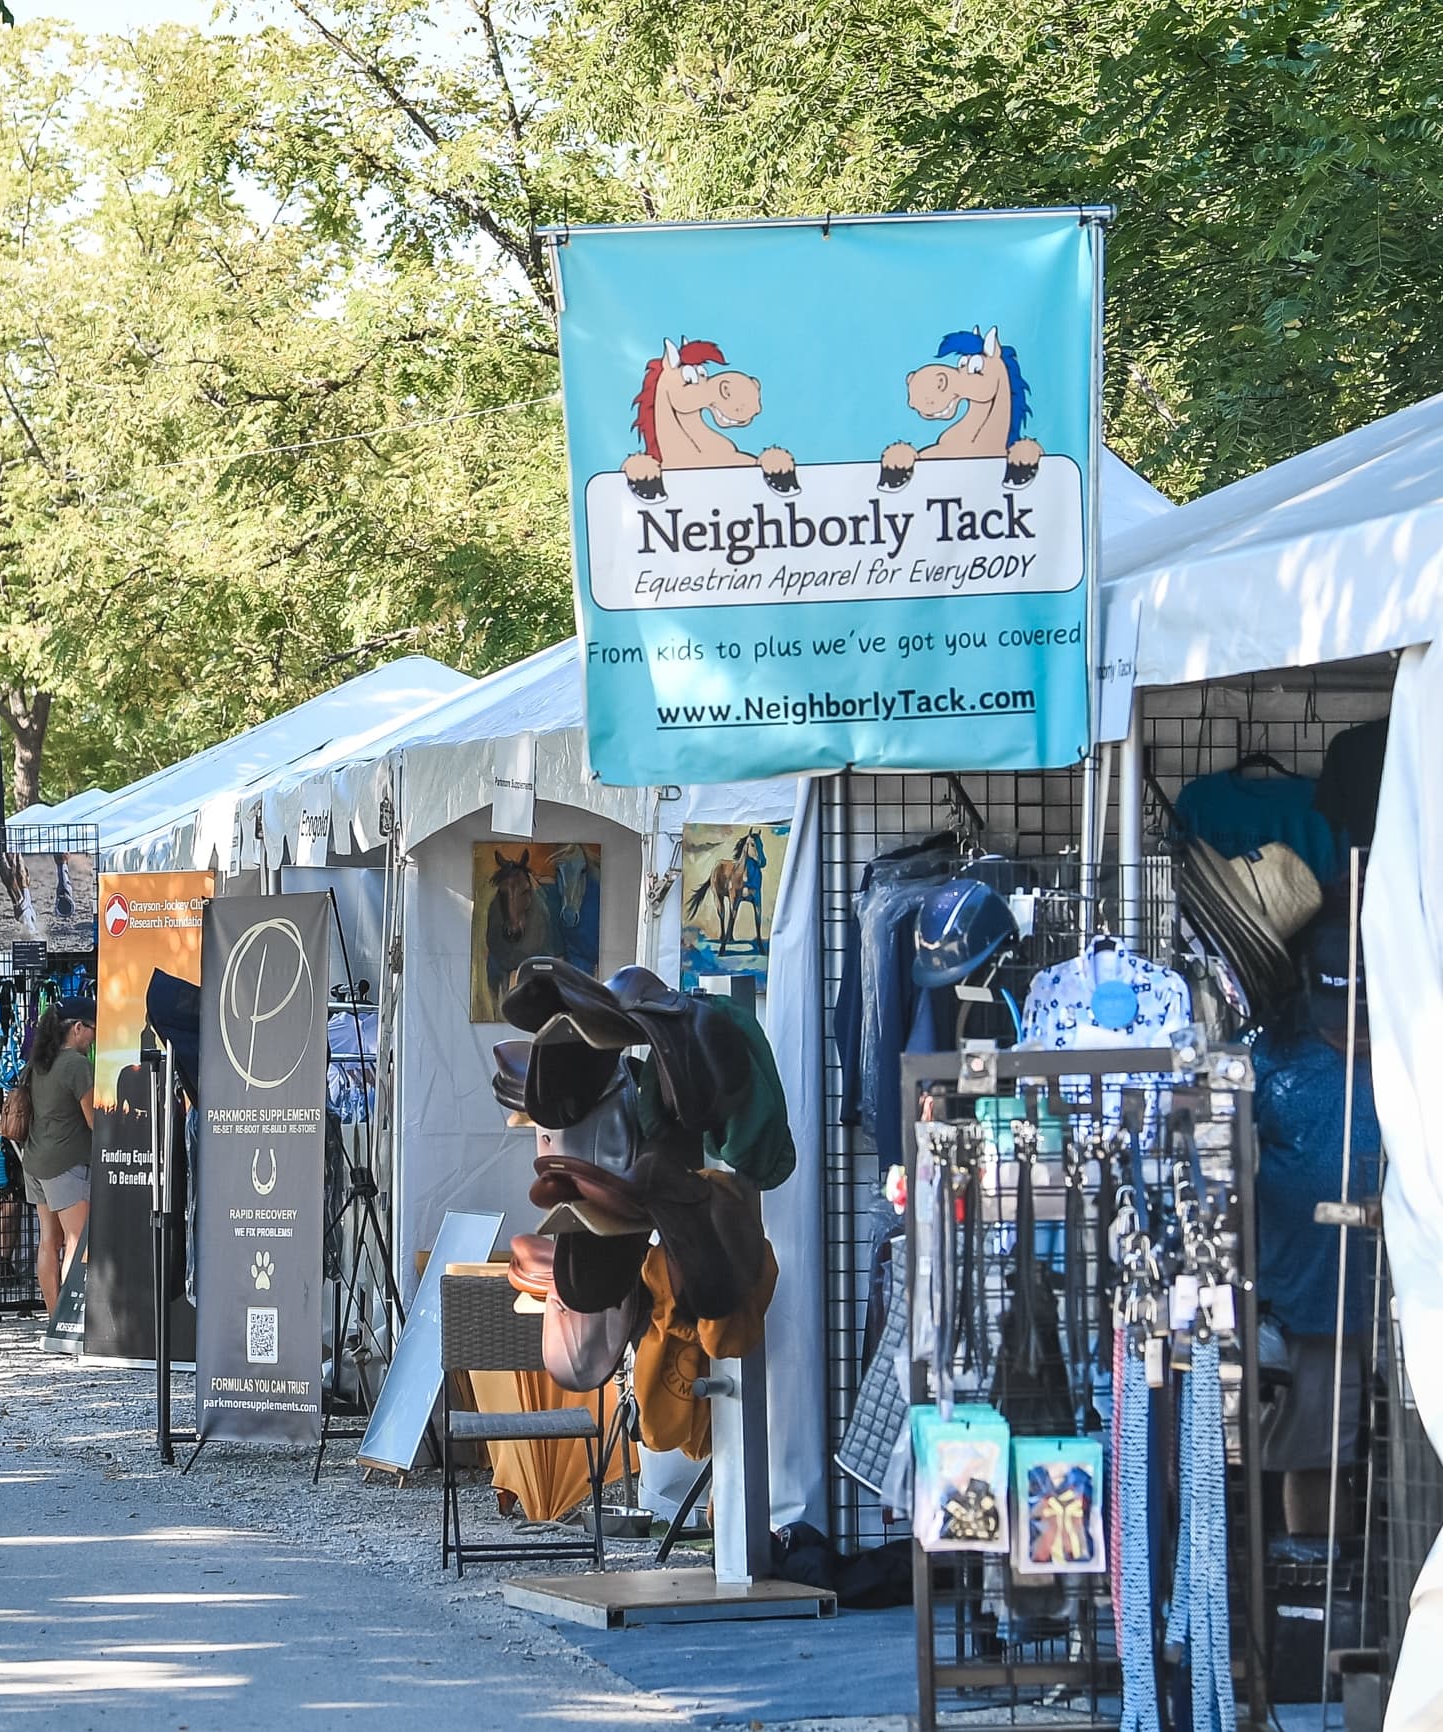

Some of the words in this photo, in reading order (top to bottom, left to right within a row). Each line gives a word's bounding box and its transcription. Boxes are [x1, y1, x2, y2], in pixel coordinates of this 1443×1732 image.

[637, 501, 914, 566] Neighborly
[926, 493, 1036, 544] Tack
[634, 569, 763, 603] Equestrian
[768, 563, 861, 599] Apparel
[867, 556, 902, 585] for
[909, 552, 1037, 592] EveryBODY
[587, 642, 644, 665] From
[656, 635, 705, 663] kids
[716, 637, 742, 660] to
[753, 633, 803, 668] plus
[811, 629, 887, 657] we've
[897, 628, 935, 660] got
[944, 630, 988, 657] you
[997, 620, 1081, 648] covered
[656, 686, 1036, 725] www.NeighborlyTack.com
[129, 898, 190, 912] Grayson-Jockey
[189, 898, 204, 910] Clu
[129, 916, 163, 929] Research
[164, 915, 202, 929] Foundatio
[207, 1109, 257, 1122] PARKMORE
[259, 1108, 321, 1121] SUPPLEMENTS
[101, 1149, 132, 1166] Funding
[108, 1171, 118, 1185] To
[119, 1171, 147, 1186] Benefit
[229, 1209, 254, 1220] RAPID
[255, 1209, 298, 1220] RECOVERY
[234, 1227, 245, 1237] WE
[246, 1227, 256, 1237] FIX
[211, 1377, 254, 1393] FORMULAS
[254, 1379, 270, 1393] YOU
[271, 1380, 286, 1394] CAN
[287, 1381, 310, 1395] TRUST
[203, 1397, 318, 1413] parkmoresupplements.com
